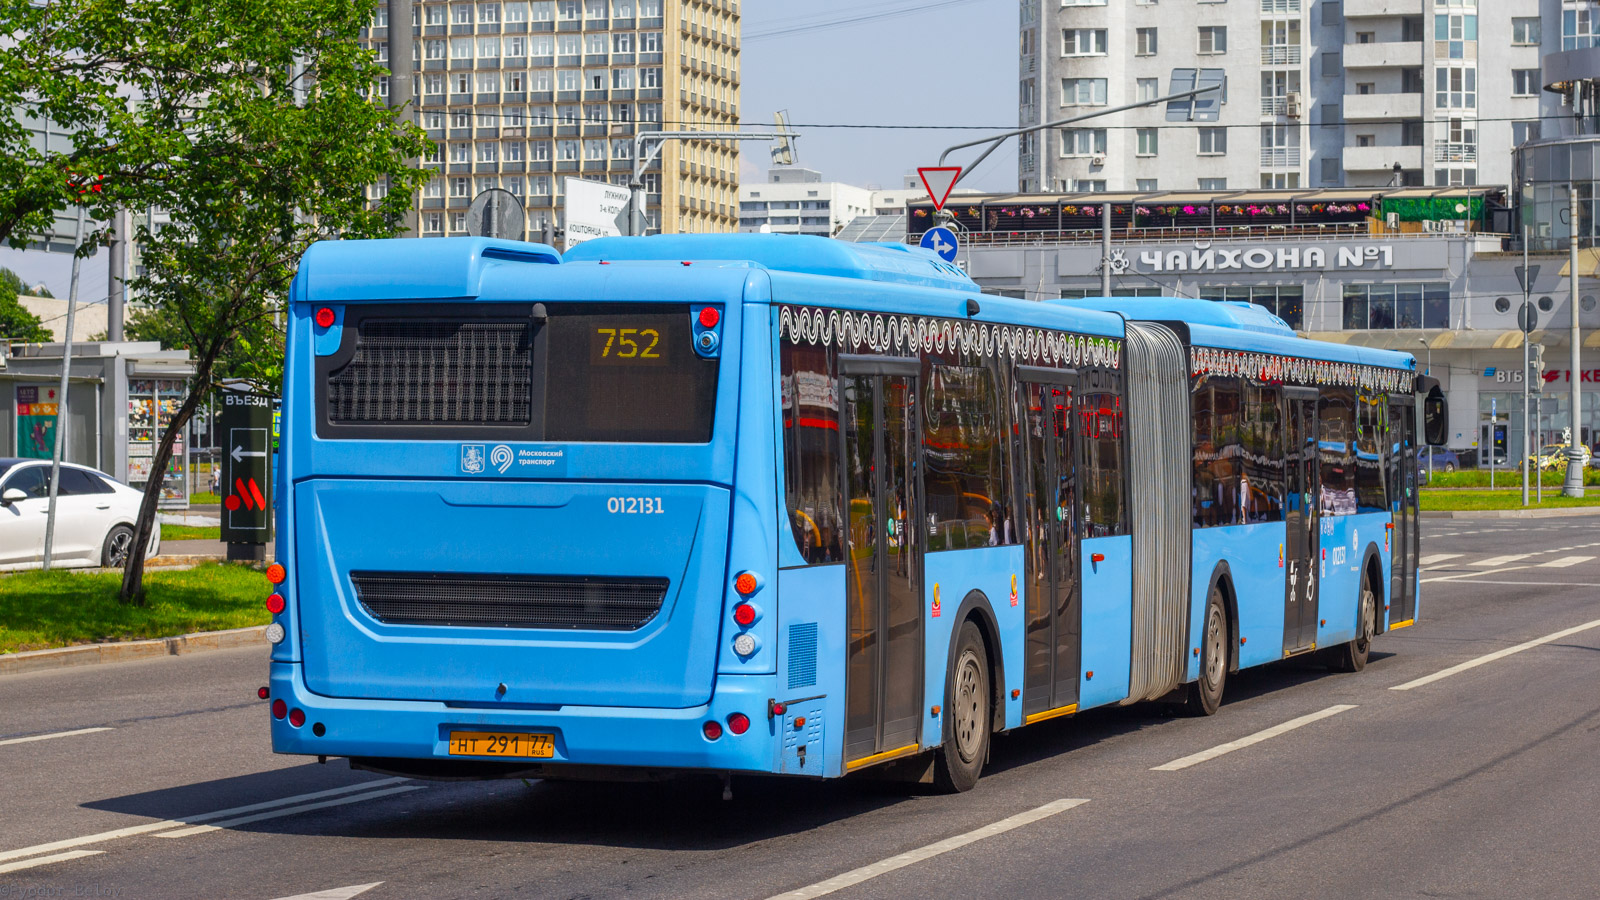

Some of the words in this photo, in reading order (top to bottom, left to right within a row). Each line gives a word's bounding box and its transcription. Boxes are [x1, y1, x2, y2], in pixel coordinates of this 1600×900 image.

[1140, 241, 1325, 271] ЧАЙХОНА
[1338, 245, 1393, 268] №1
[597, 328, 660, 358] 752
[1496, 370, 1523, 383] ВТБ
[226, 395, 268, 408] ВЪЕЗД
[518, 449, 564, 458] Московский
[518, 458, 556, 467] транспорт
[607, 496, 665, 514] 012131
[487, 735, 519, 754] 291
[531, 735, 548, 749] 77
